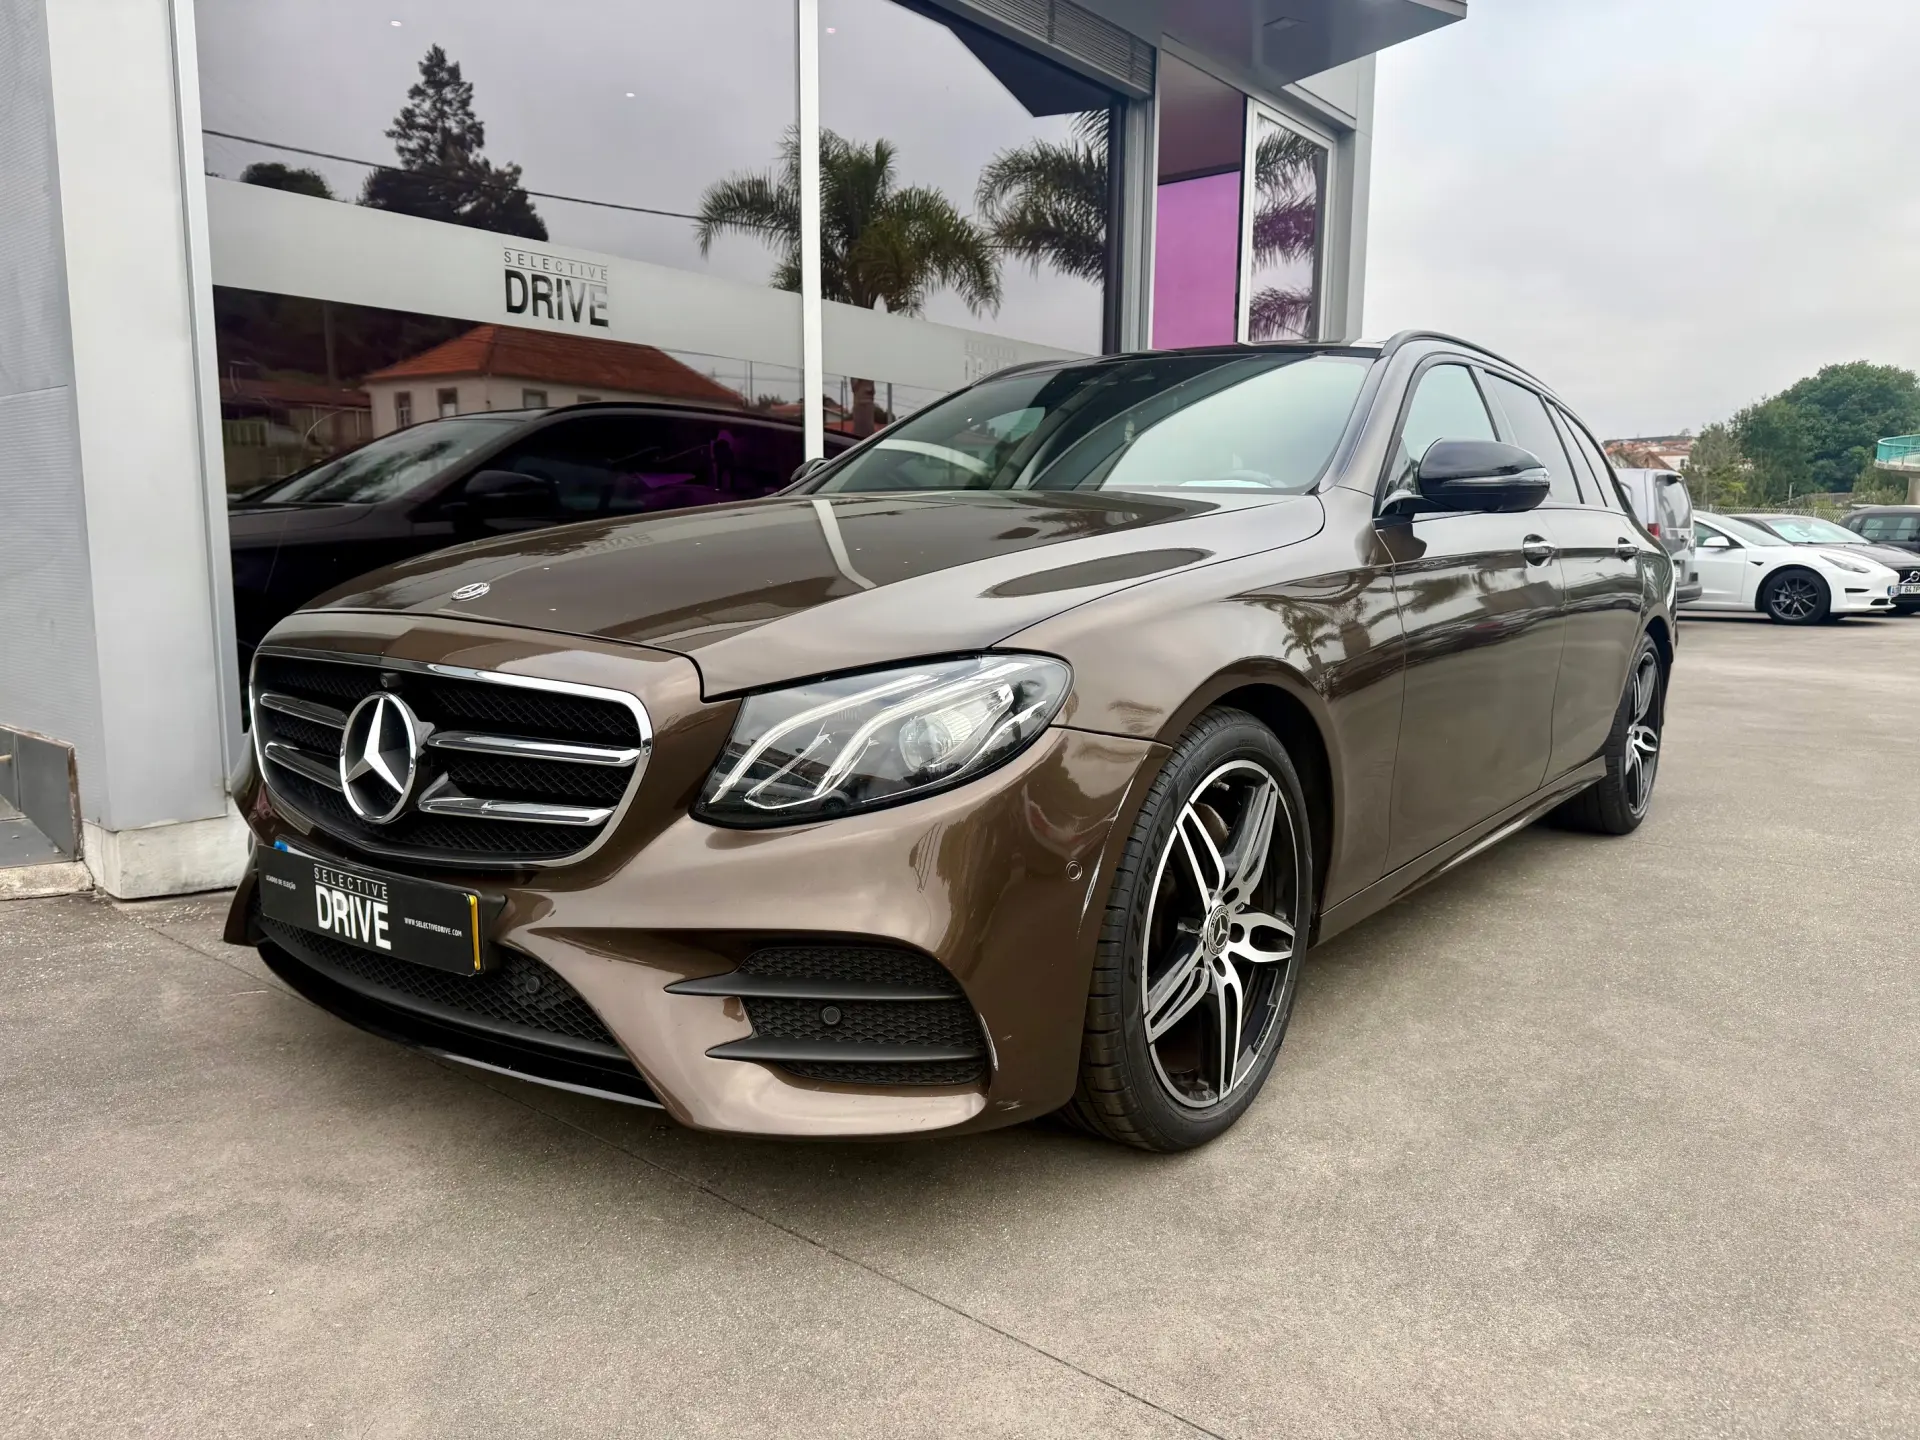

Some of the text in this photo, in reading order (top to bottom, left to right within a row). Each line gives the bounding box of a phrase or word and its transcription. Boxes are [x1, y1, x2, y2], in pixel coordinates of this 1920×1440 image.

[504, 251, 608, 281] SELECTIVE
[505, 269, 609, 327] DRIVE
[314, 867, 388, 899] SELECTIVE
[1131, 823, 1164, 946] ZERO
[315, 884, 392, 950] DRIVE
